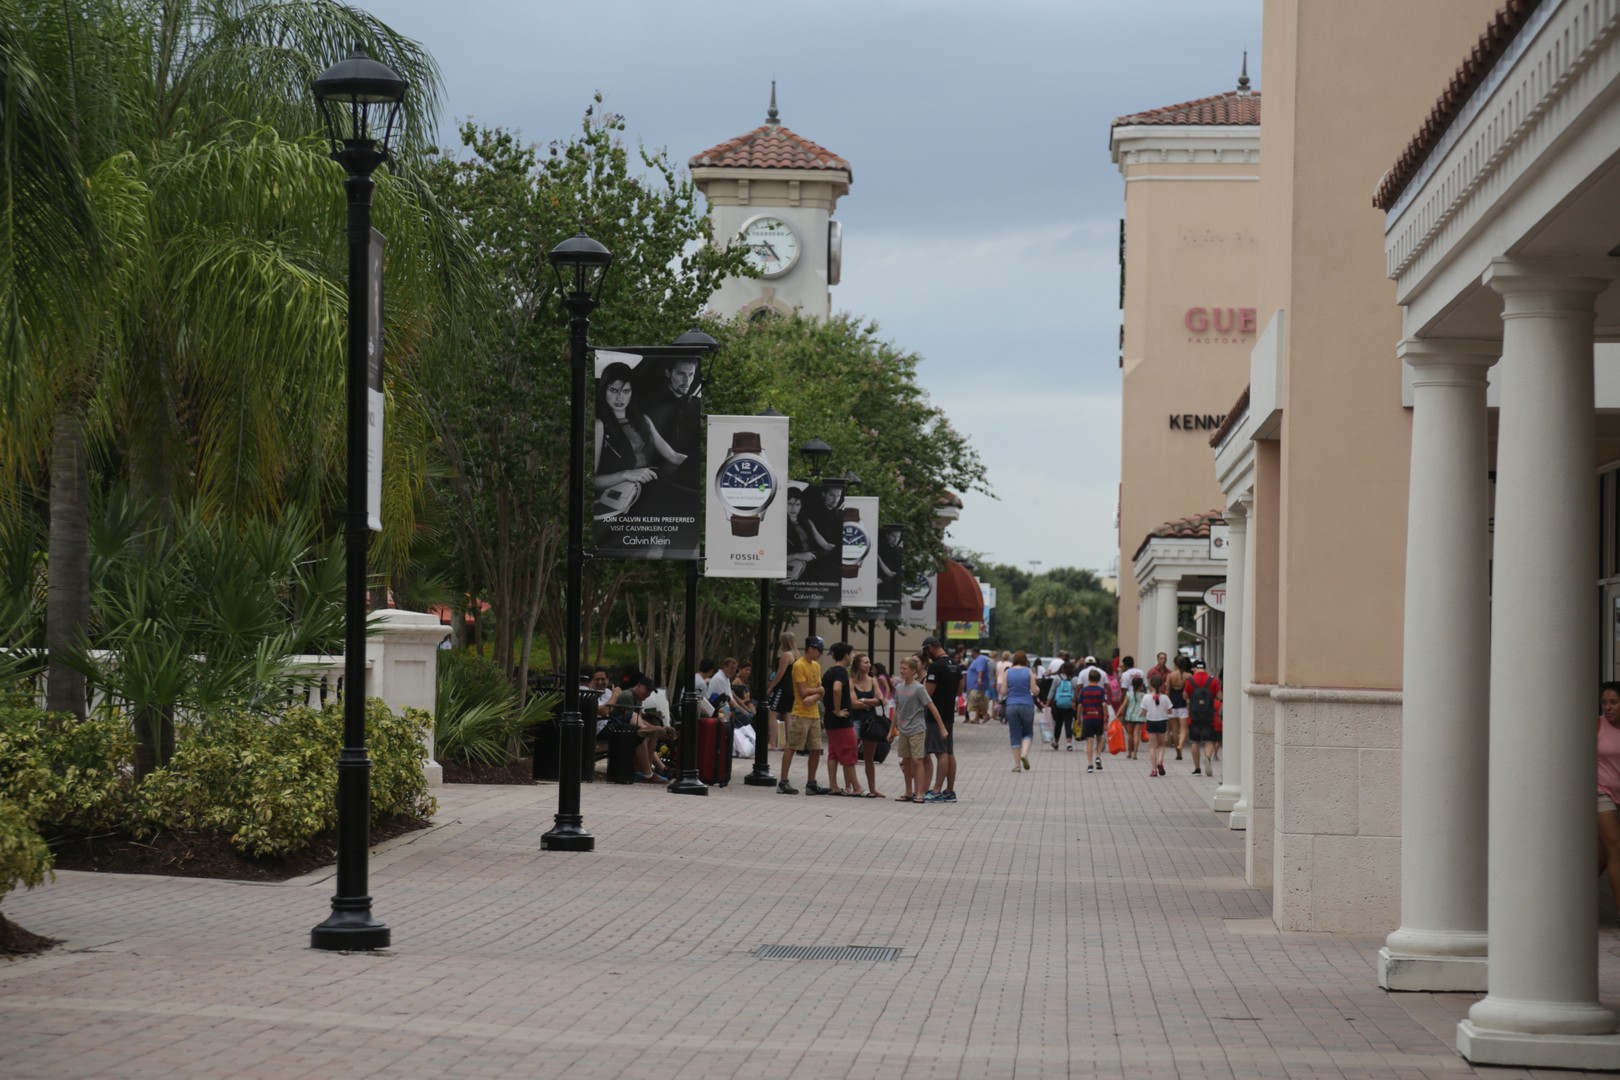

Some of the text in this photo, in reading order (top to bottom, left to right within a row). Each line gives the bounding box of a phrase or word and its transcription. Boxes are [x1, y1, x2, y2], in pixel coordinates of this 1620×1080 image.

[1187, 337, 1247, 345] FACTORY
[622, 535, 671, 545] Calvin Klein
[730, 553, 760, 561] FOSSIL
